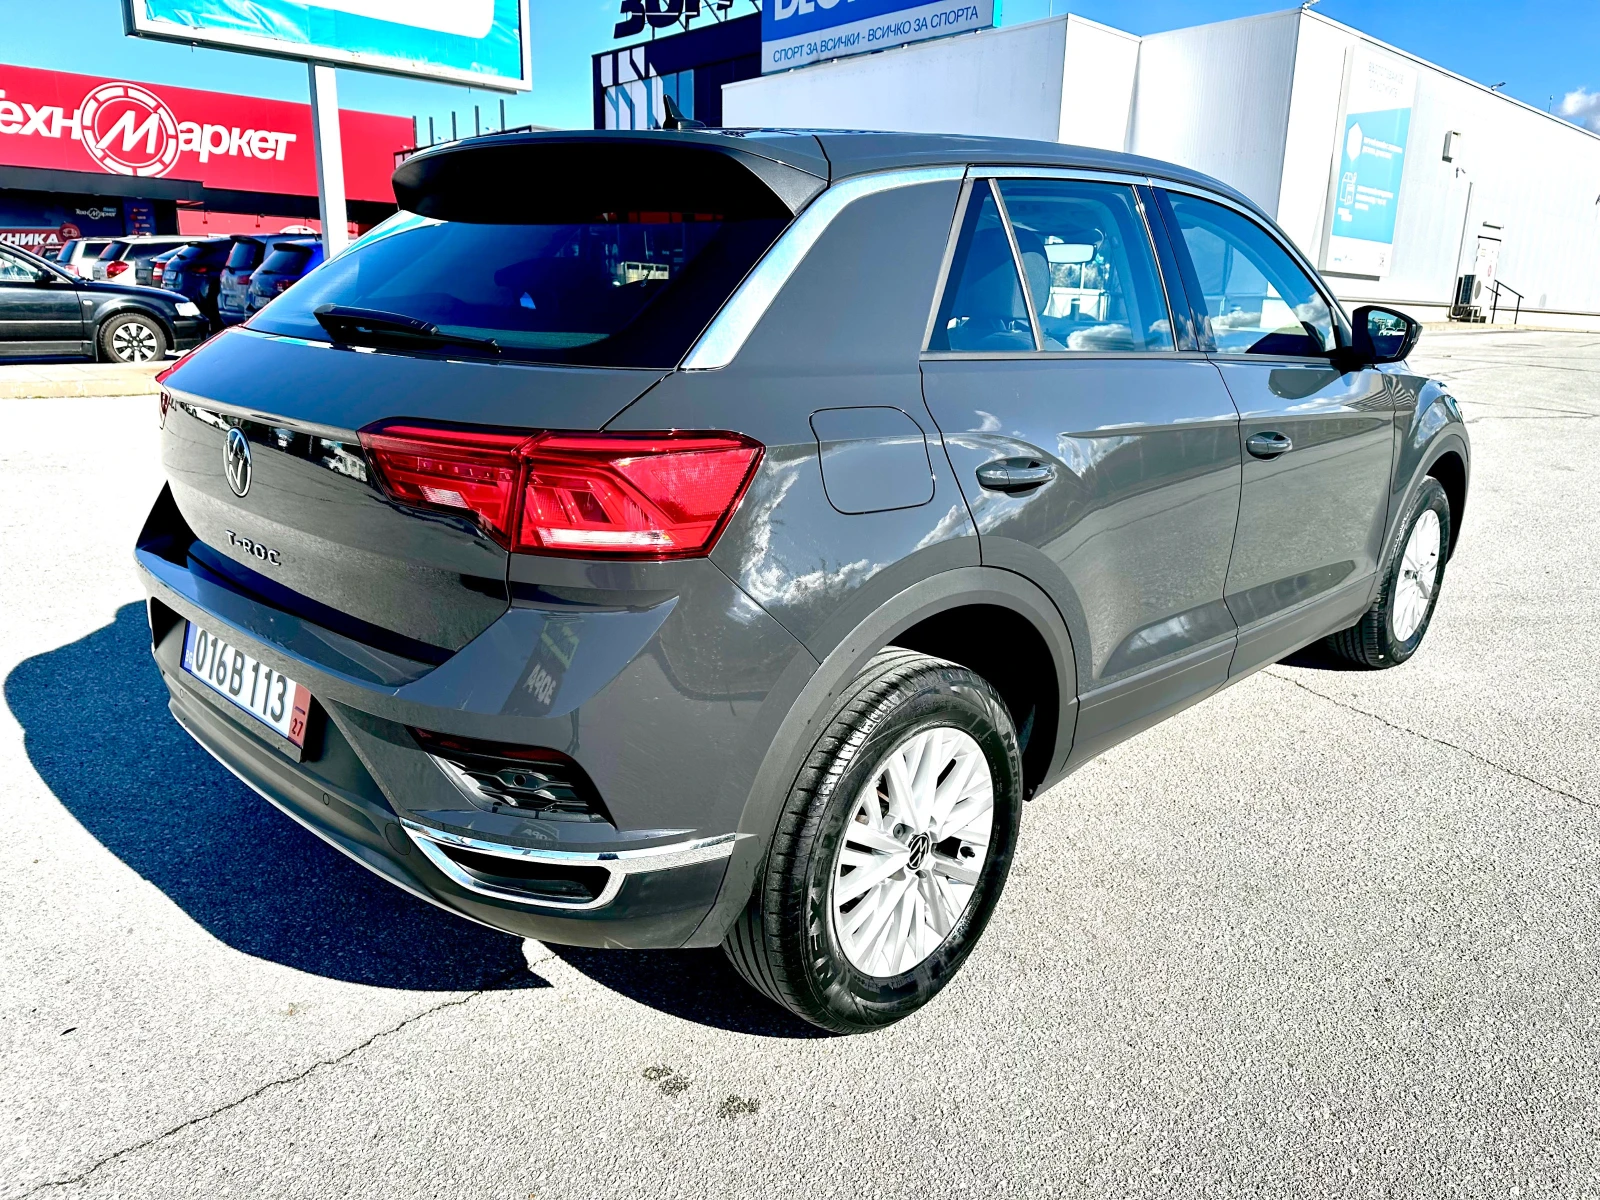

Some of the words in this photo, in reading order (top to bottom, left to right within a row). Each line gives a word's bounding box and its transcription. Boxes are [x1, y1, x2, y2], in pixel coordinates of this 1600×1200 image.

[773, 45, 804, 63] СПОРТ
[805, 42, 818, 56] ЗА
[820, 32, 860, 52] ВСИЧКИ
[868, 20, 912, 42] ВСИЧКО
[914, 17, 928, 32] ЗА
[931, 6, 979, 28] СПОРТА
[225, 530, 281, 566] T-ROC
[195, 629, 288, 723] 016B113
[291, 718, 304, 737] 27
